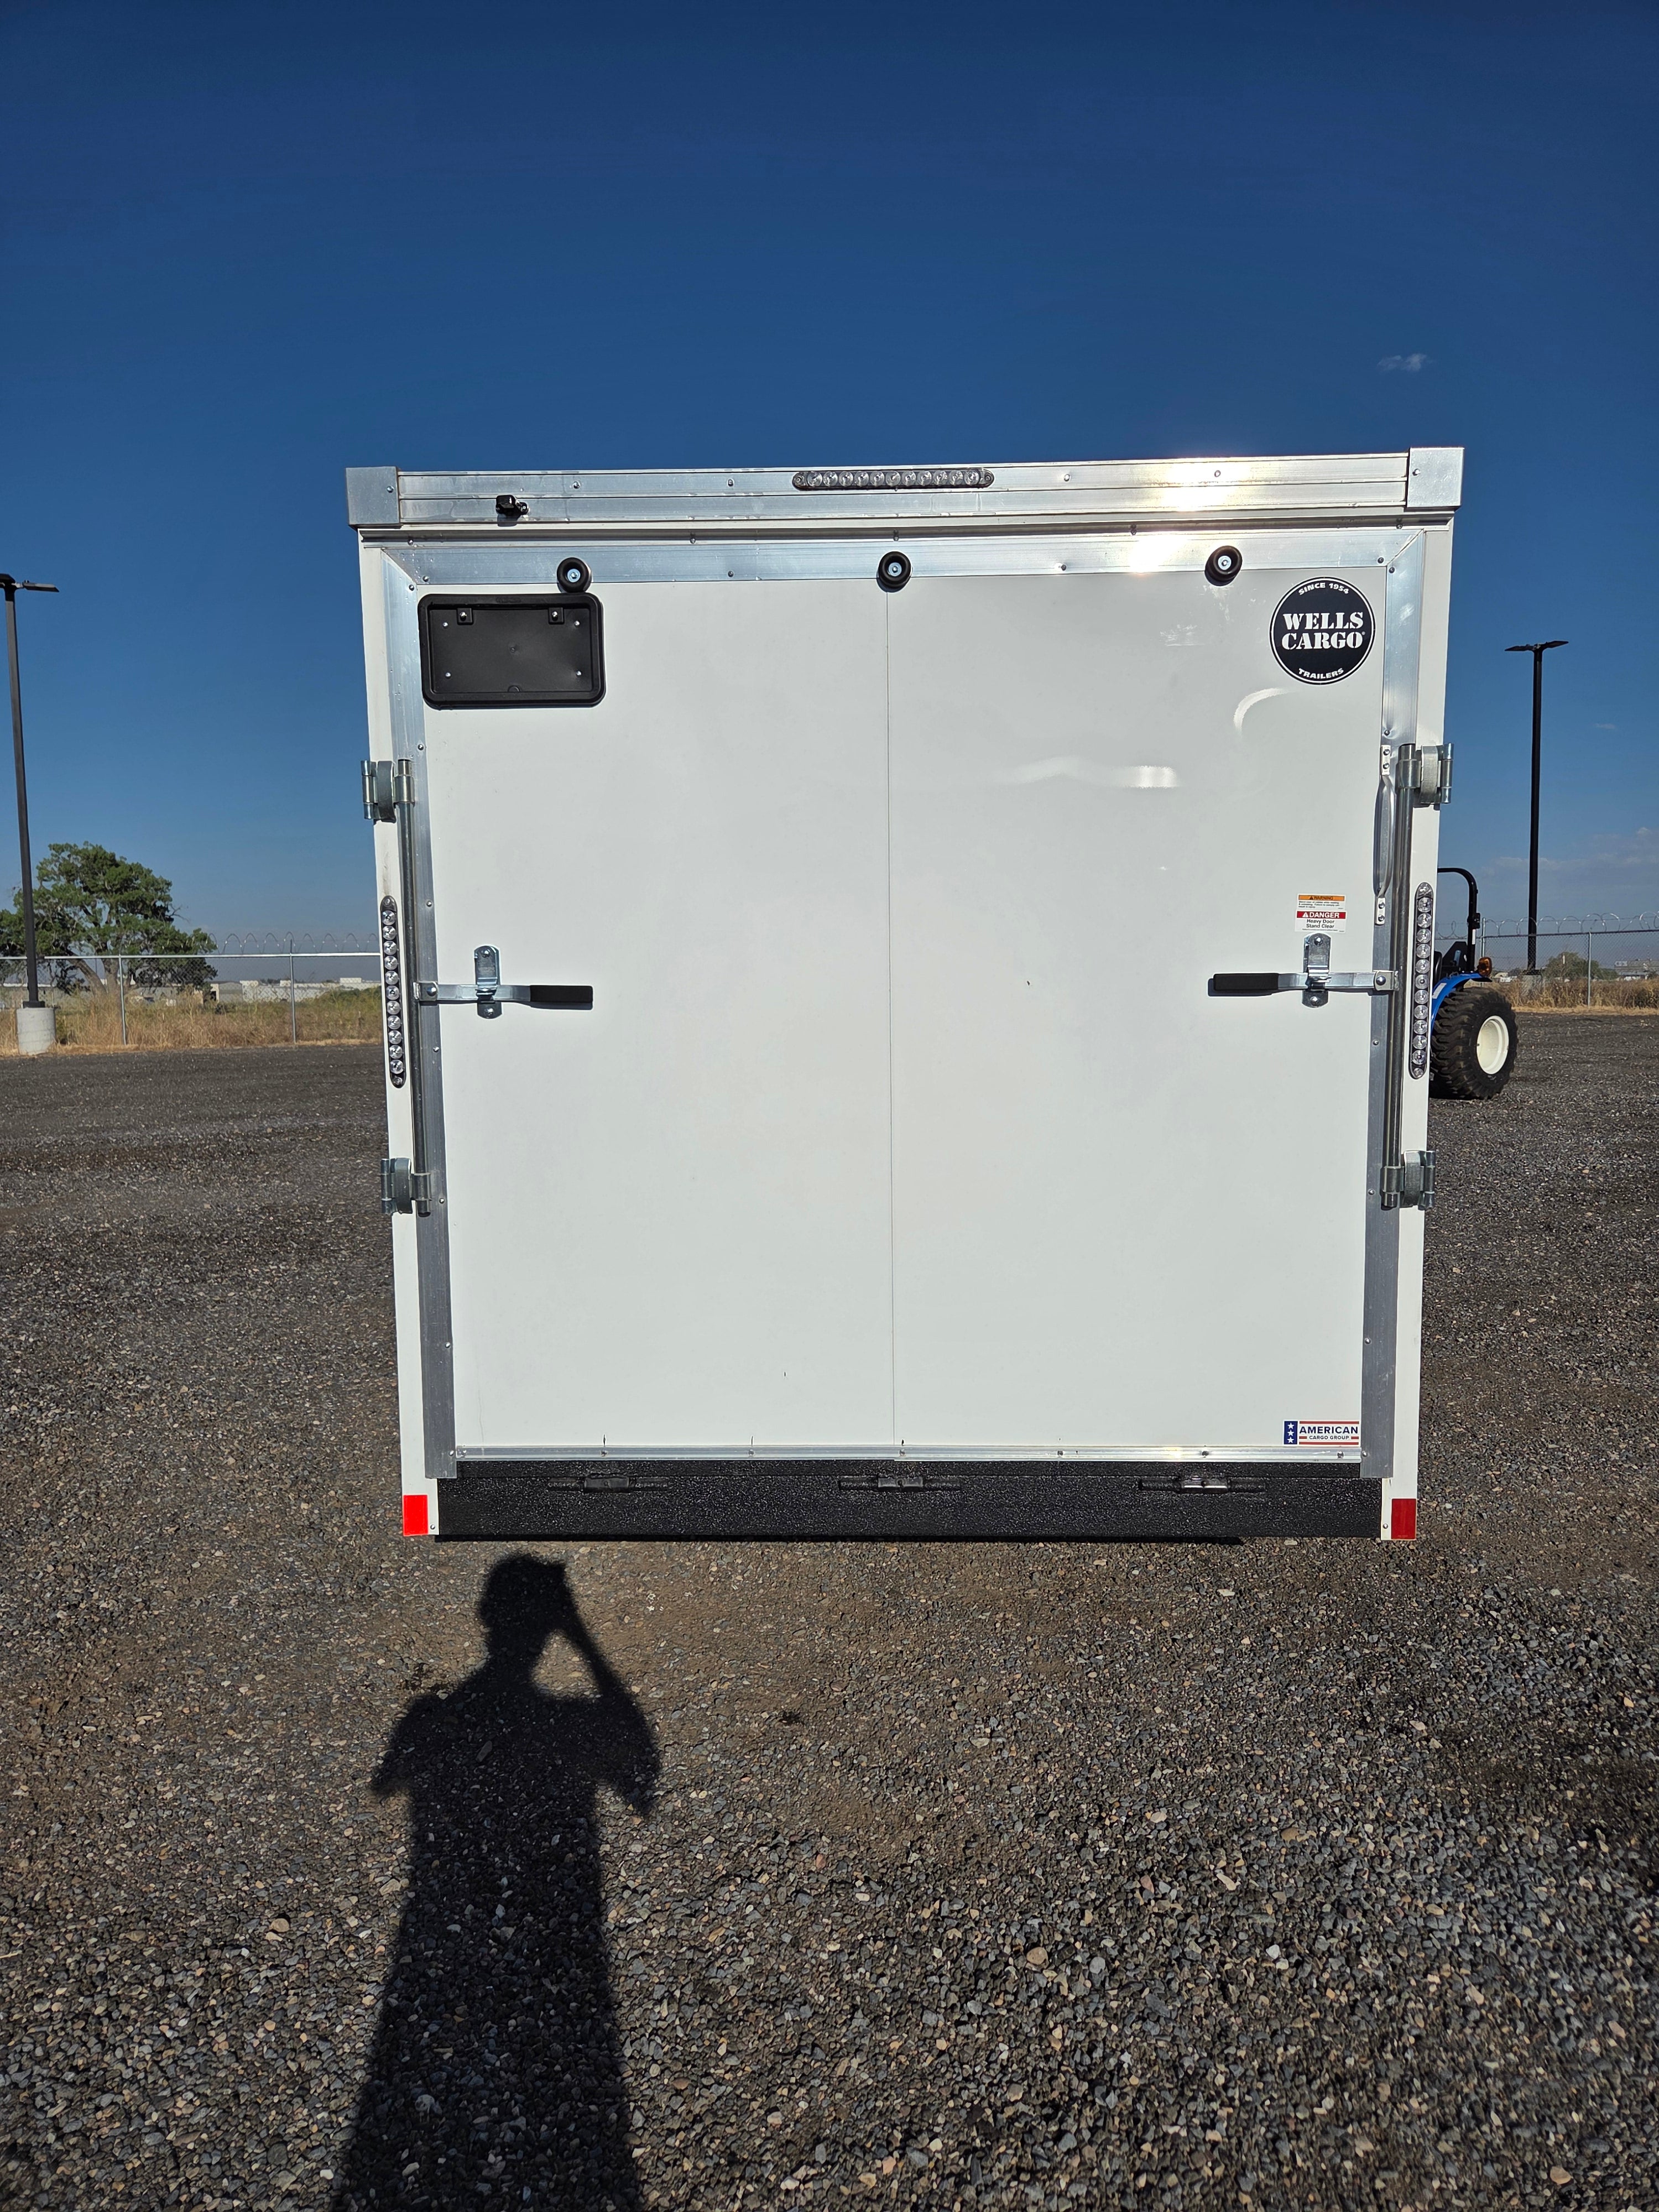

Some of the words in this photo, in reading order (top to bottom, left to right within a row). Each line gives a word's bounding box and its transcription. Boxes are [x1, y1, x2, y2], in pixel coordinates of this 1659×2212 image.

[1298, 582, 1326, 595] SINCE
[1329, 583, 1349, 594] 1954
[1282, 612, 1364, 630] WELLS
[1281, 632, 1364, 650] CARGO
[1298, 668, 1344, 679] TRAILERS
